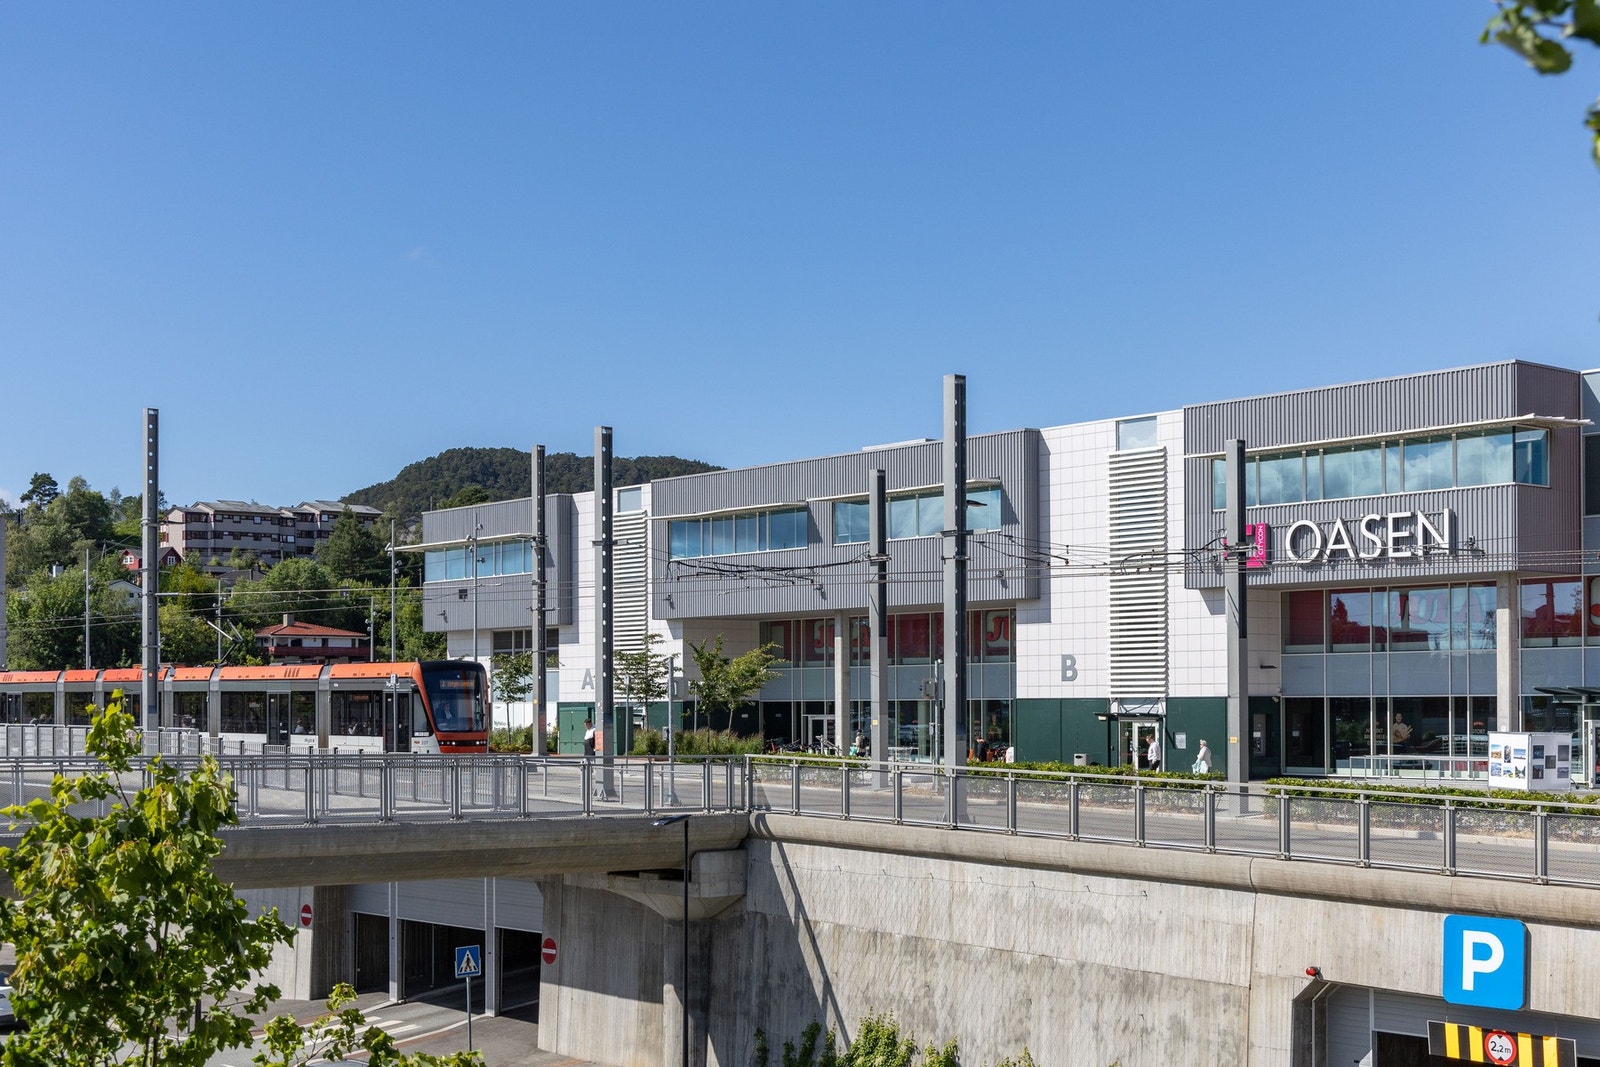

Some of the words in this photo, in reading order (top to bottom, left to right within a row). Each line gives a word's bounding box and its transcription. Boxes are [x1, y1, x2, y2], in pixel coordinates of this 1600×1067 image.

[1285, 508, 1449, 564] OASEN
[581, 668, 594, 690] A
[1061, 654, 1078, 682] B
[1462, 930, 1504, 991] P
